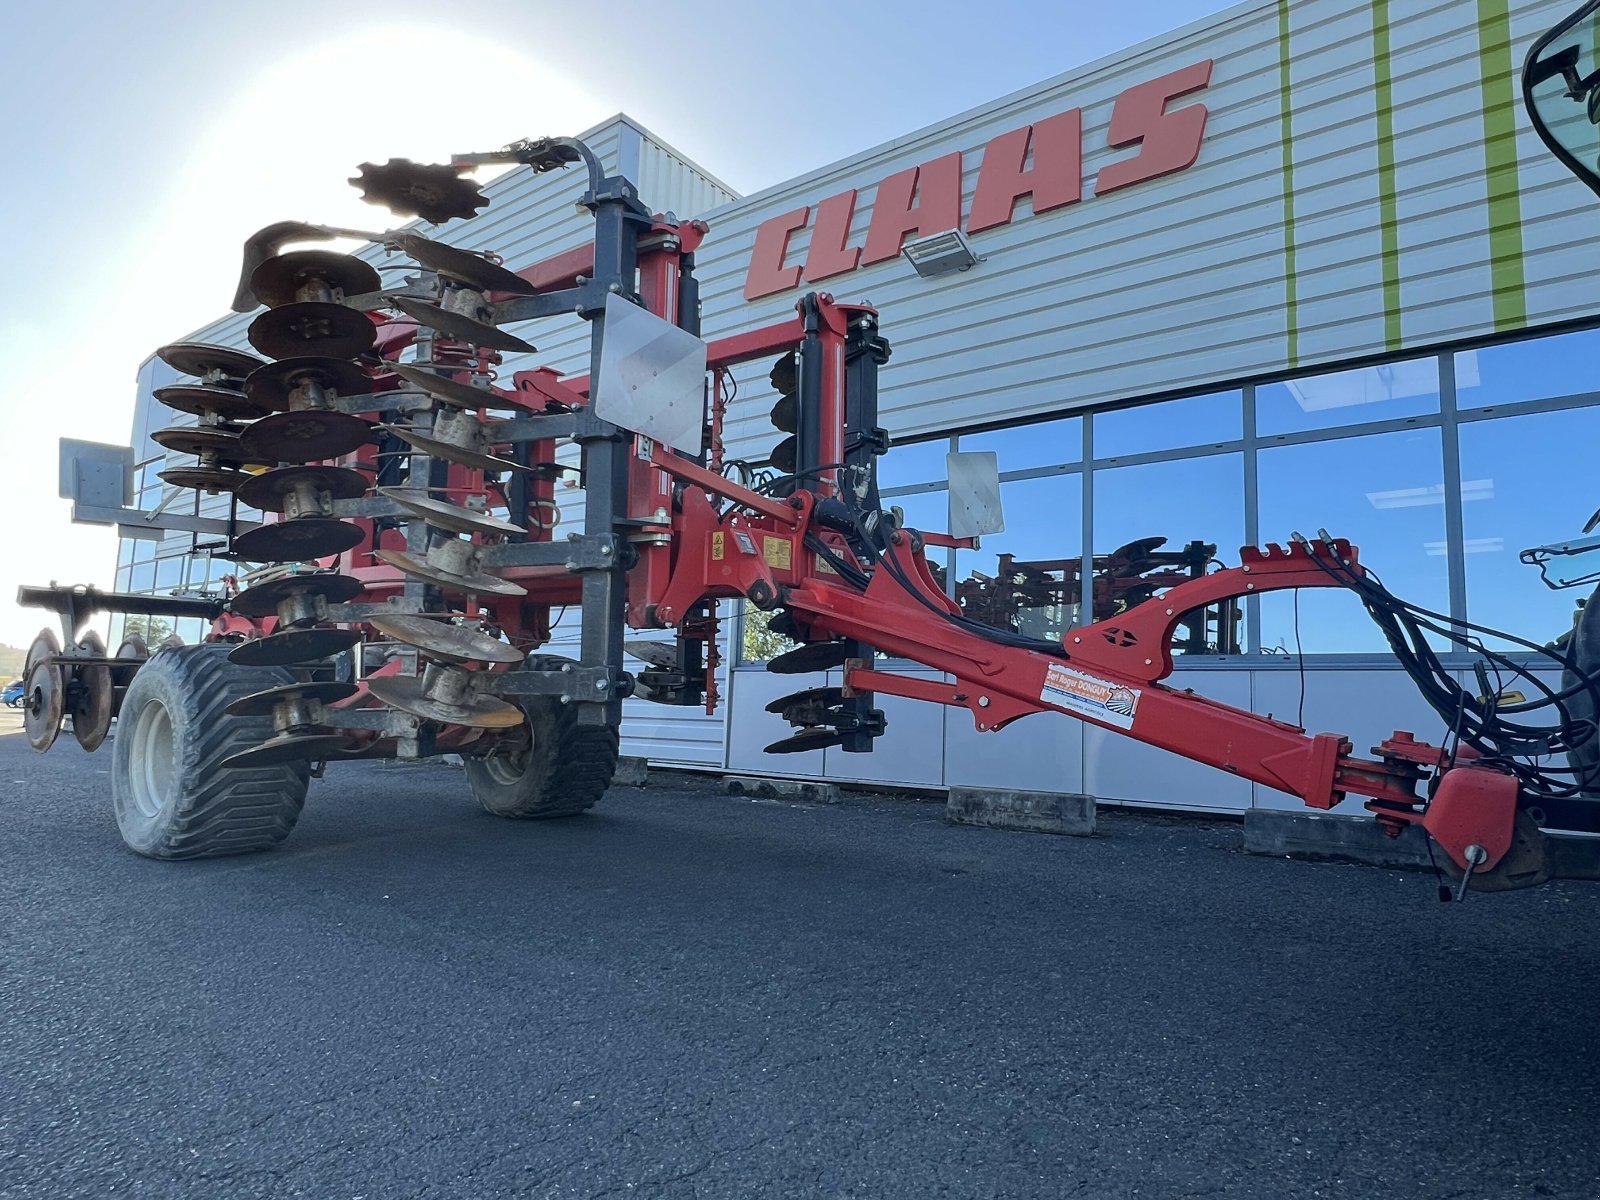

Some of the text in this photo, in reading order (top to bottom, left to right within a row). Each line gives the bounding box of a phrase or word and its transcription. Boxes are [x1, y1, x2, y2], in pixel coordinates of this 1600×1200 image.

[744, 58, 1213, 301] CLAAS
[1046, 670, 1060, 681] Sarl
[1060, 674, 1078, 687] Roger
[1078, 680, 1107, 696] DONGUY
